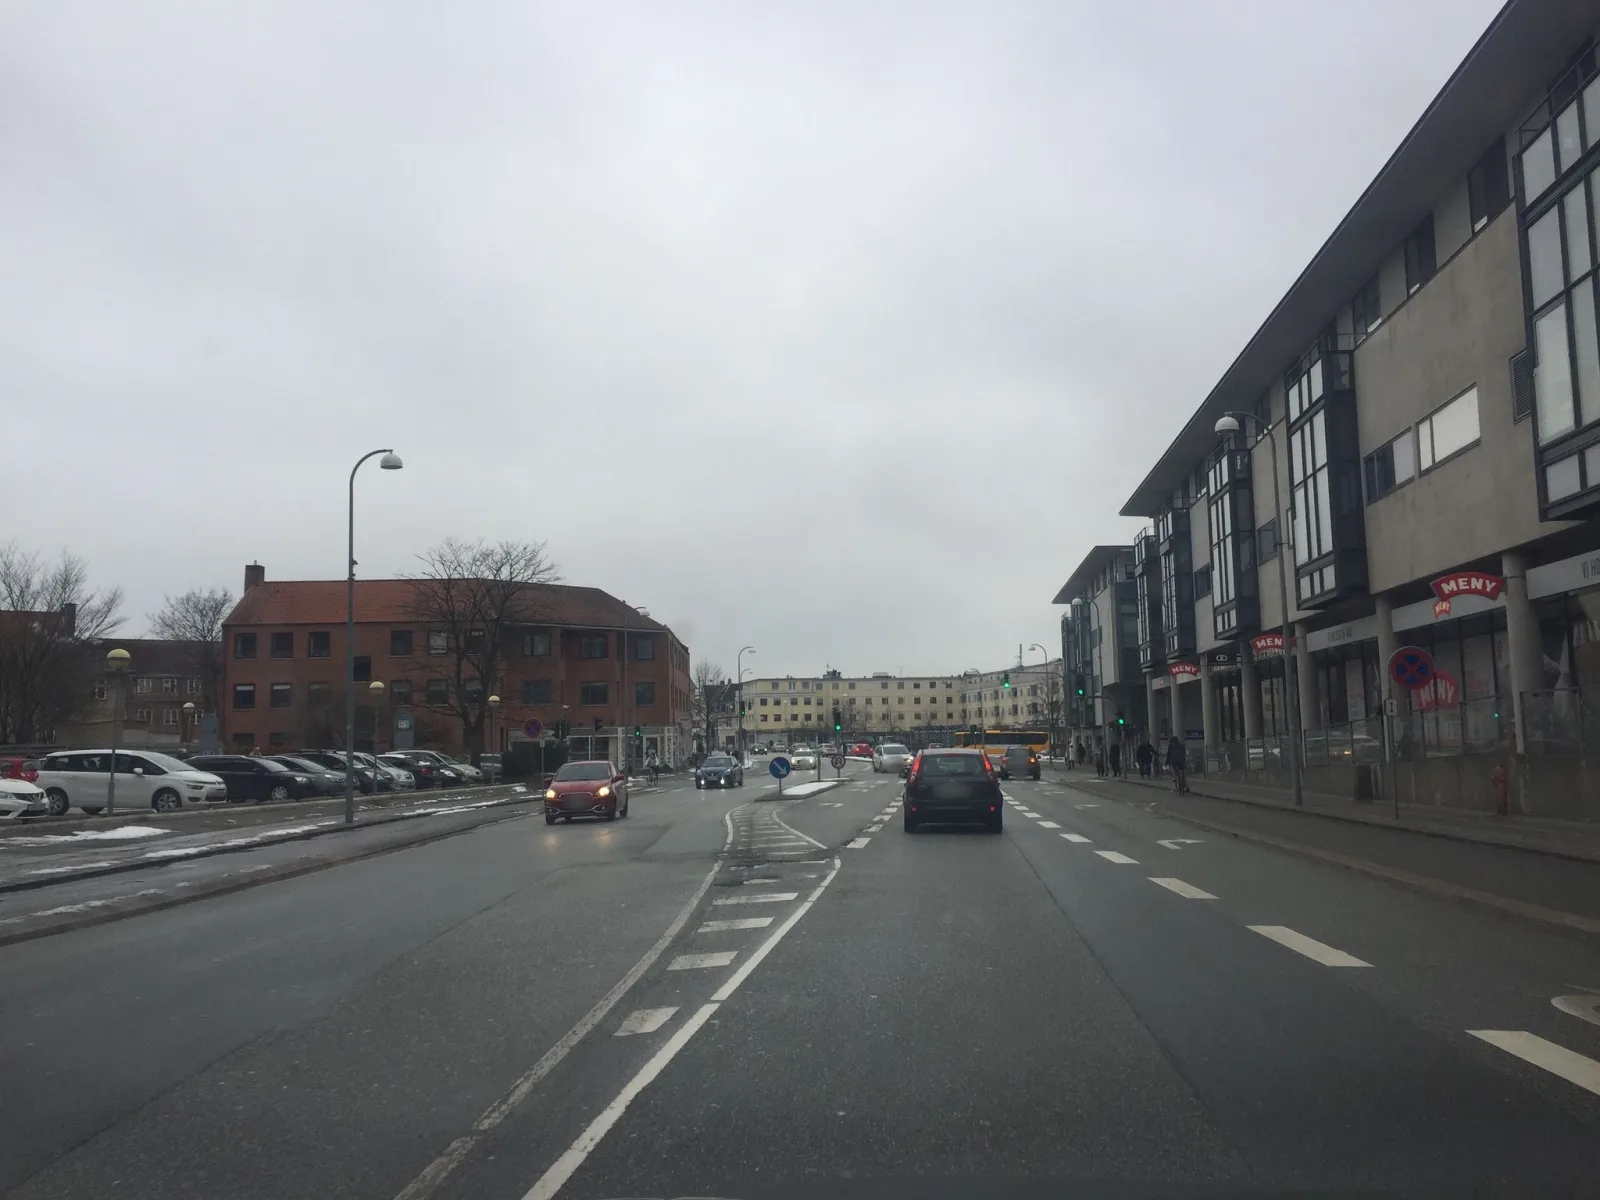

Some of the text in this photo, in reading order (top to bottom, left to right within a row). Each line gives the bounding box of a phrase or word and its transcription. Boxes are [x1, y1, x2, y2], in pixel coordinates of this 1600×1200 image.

[1441, 577, 1497, 594] MENY
[1256, 636, 1283, 648] MEN
[1171, 665, 1197, 674] MENY
